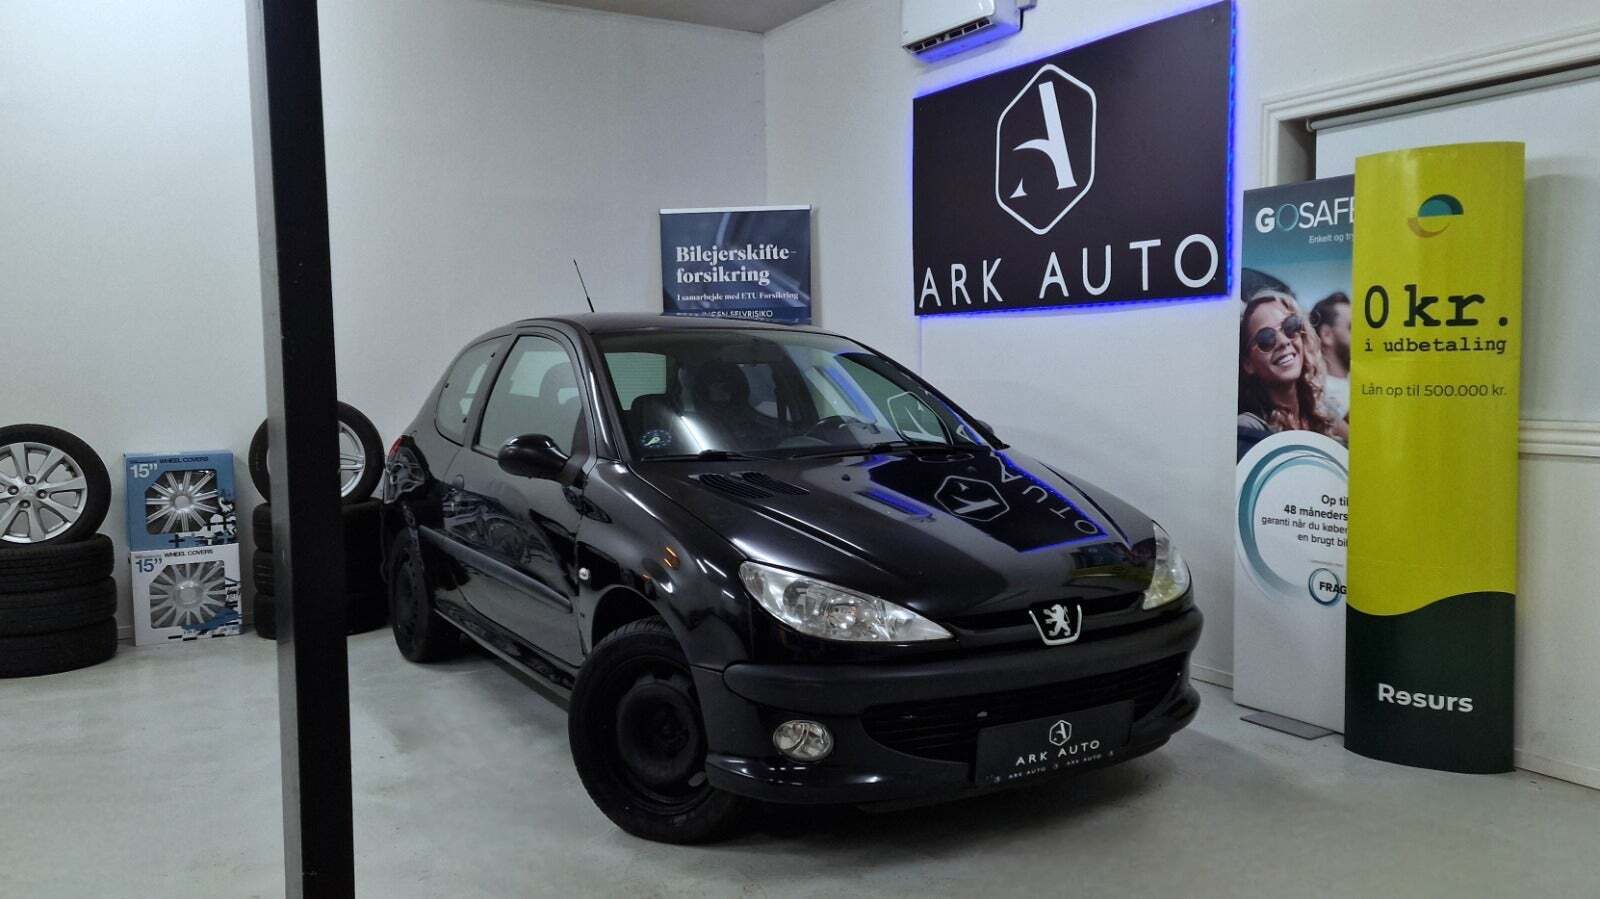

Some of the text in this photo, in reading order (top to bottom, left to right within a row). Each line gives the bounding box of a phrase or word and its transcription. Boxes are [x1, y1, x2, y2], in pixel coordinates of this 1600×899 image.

[676, 244, 797, 265] Bilejerskifte-
[676, 266, 770, 286] forsikring
[919, 233, 1219, 308] ARK AUTO
[724, 291, 740, 300] med
[760, 291, 799, 301] Forsikring
[1364, 284, 1508, 328] 0 kr.
[1365, 337, 1507, 355] i udbetaling
[1362, 383, 1507, 398] Lån op til 500.000 kr.
[1321, 494, 1336, 507] Op
[1284, 504, 1348, 520] 48 måneders
[1261, 516, 1290, 526] garanti
[1292, 519, 1306, 528] når
[1309, 521, 1320, 530] du
[1297, 533, 1309, 541] en
[1311, 534, 1335, 547] brugt
[1016, 740, 1100, 766] ARK AUTO
